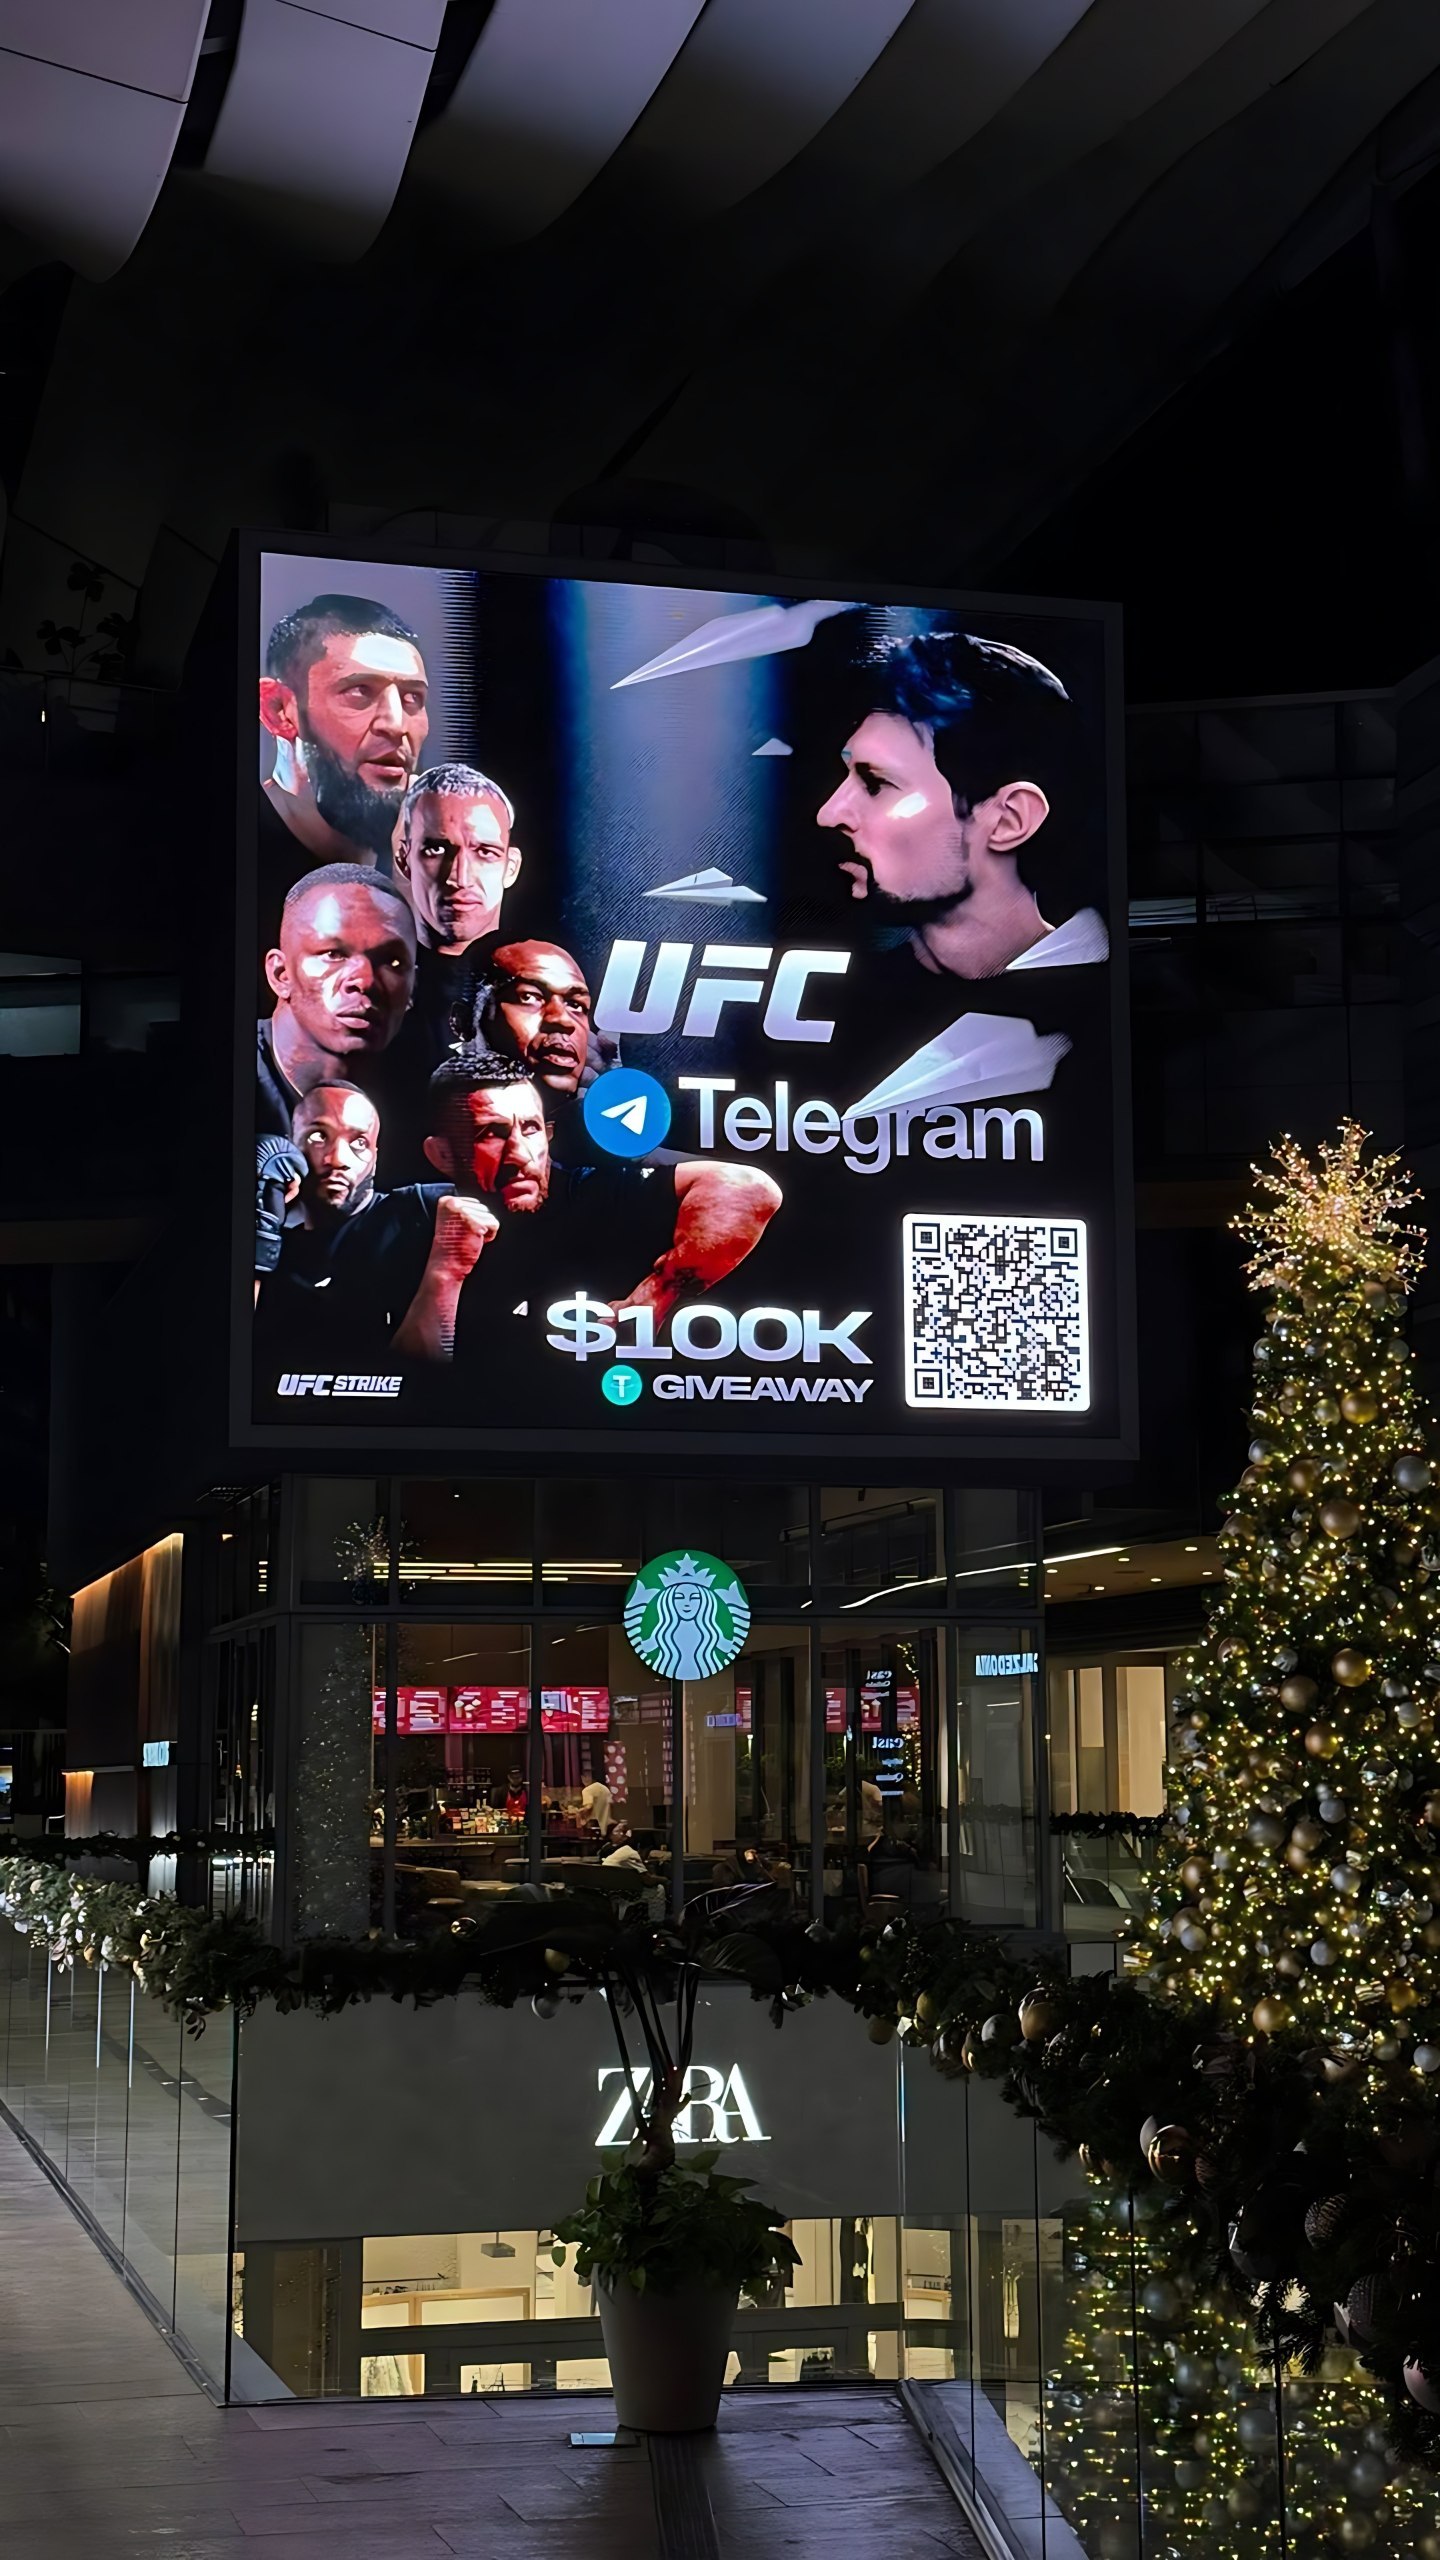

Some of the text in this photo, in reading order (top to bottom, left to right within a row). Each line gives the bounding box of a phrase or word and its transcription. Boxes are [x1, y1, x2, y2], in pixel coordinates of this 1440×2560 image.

[594, 939, 852, 1043] UFC
[678, 1076, 1045, 1174] Telegram
[546, 1291, 874, 1365] $100K
[277, 1374, 403, 1396] UFC STRIKE
[653, 1374, 874, 1403] GIVEAWAY
[595, 2063, 772, 2147] ZRA
